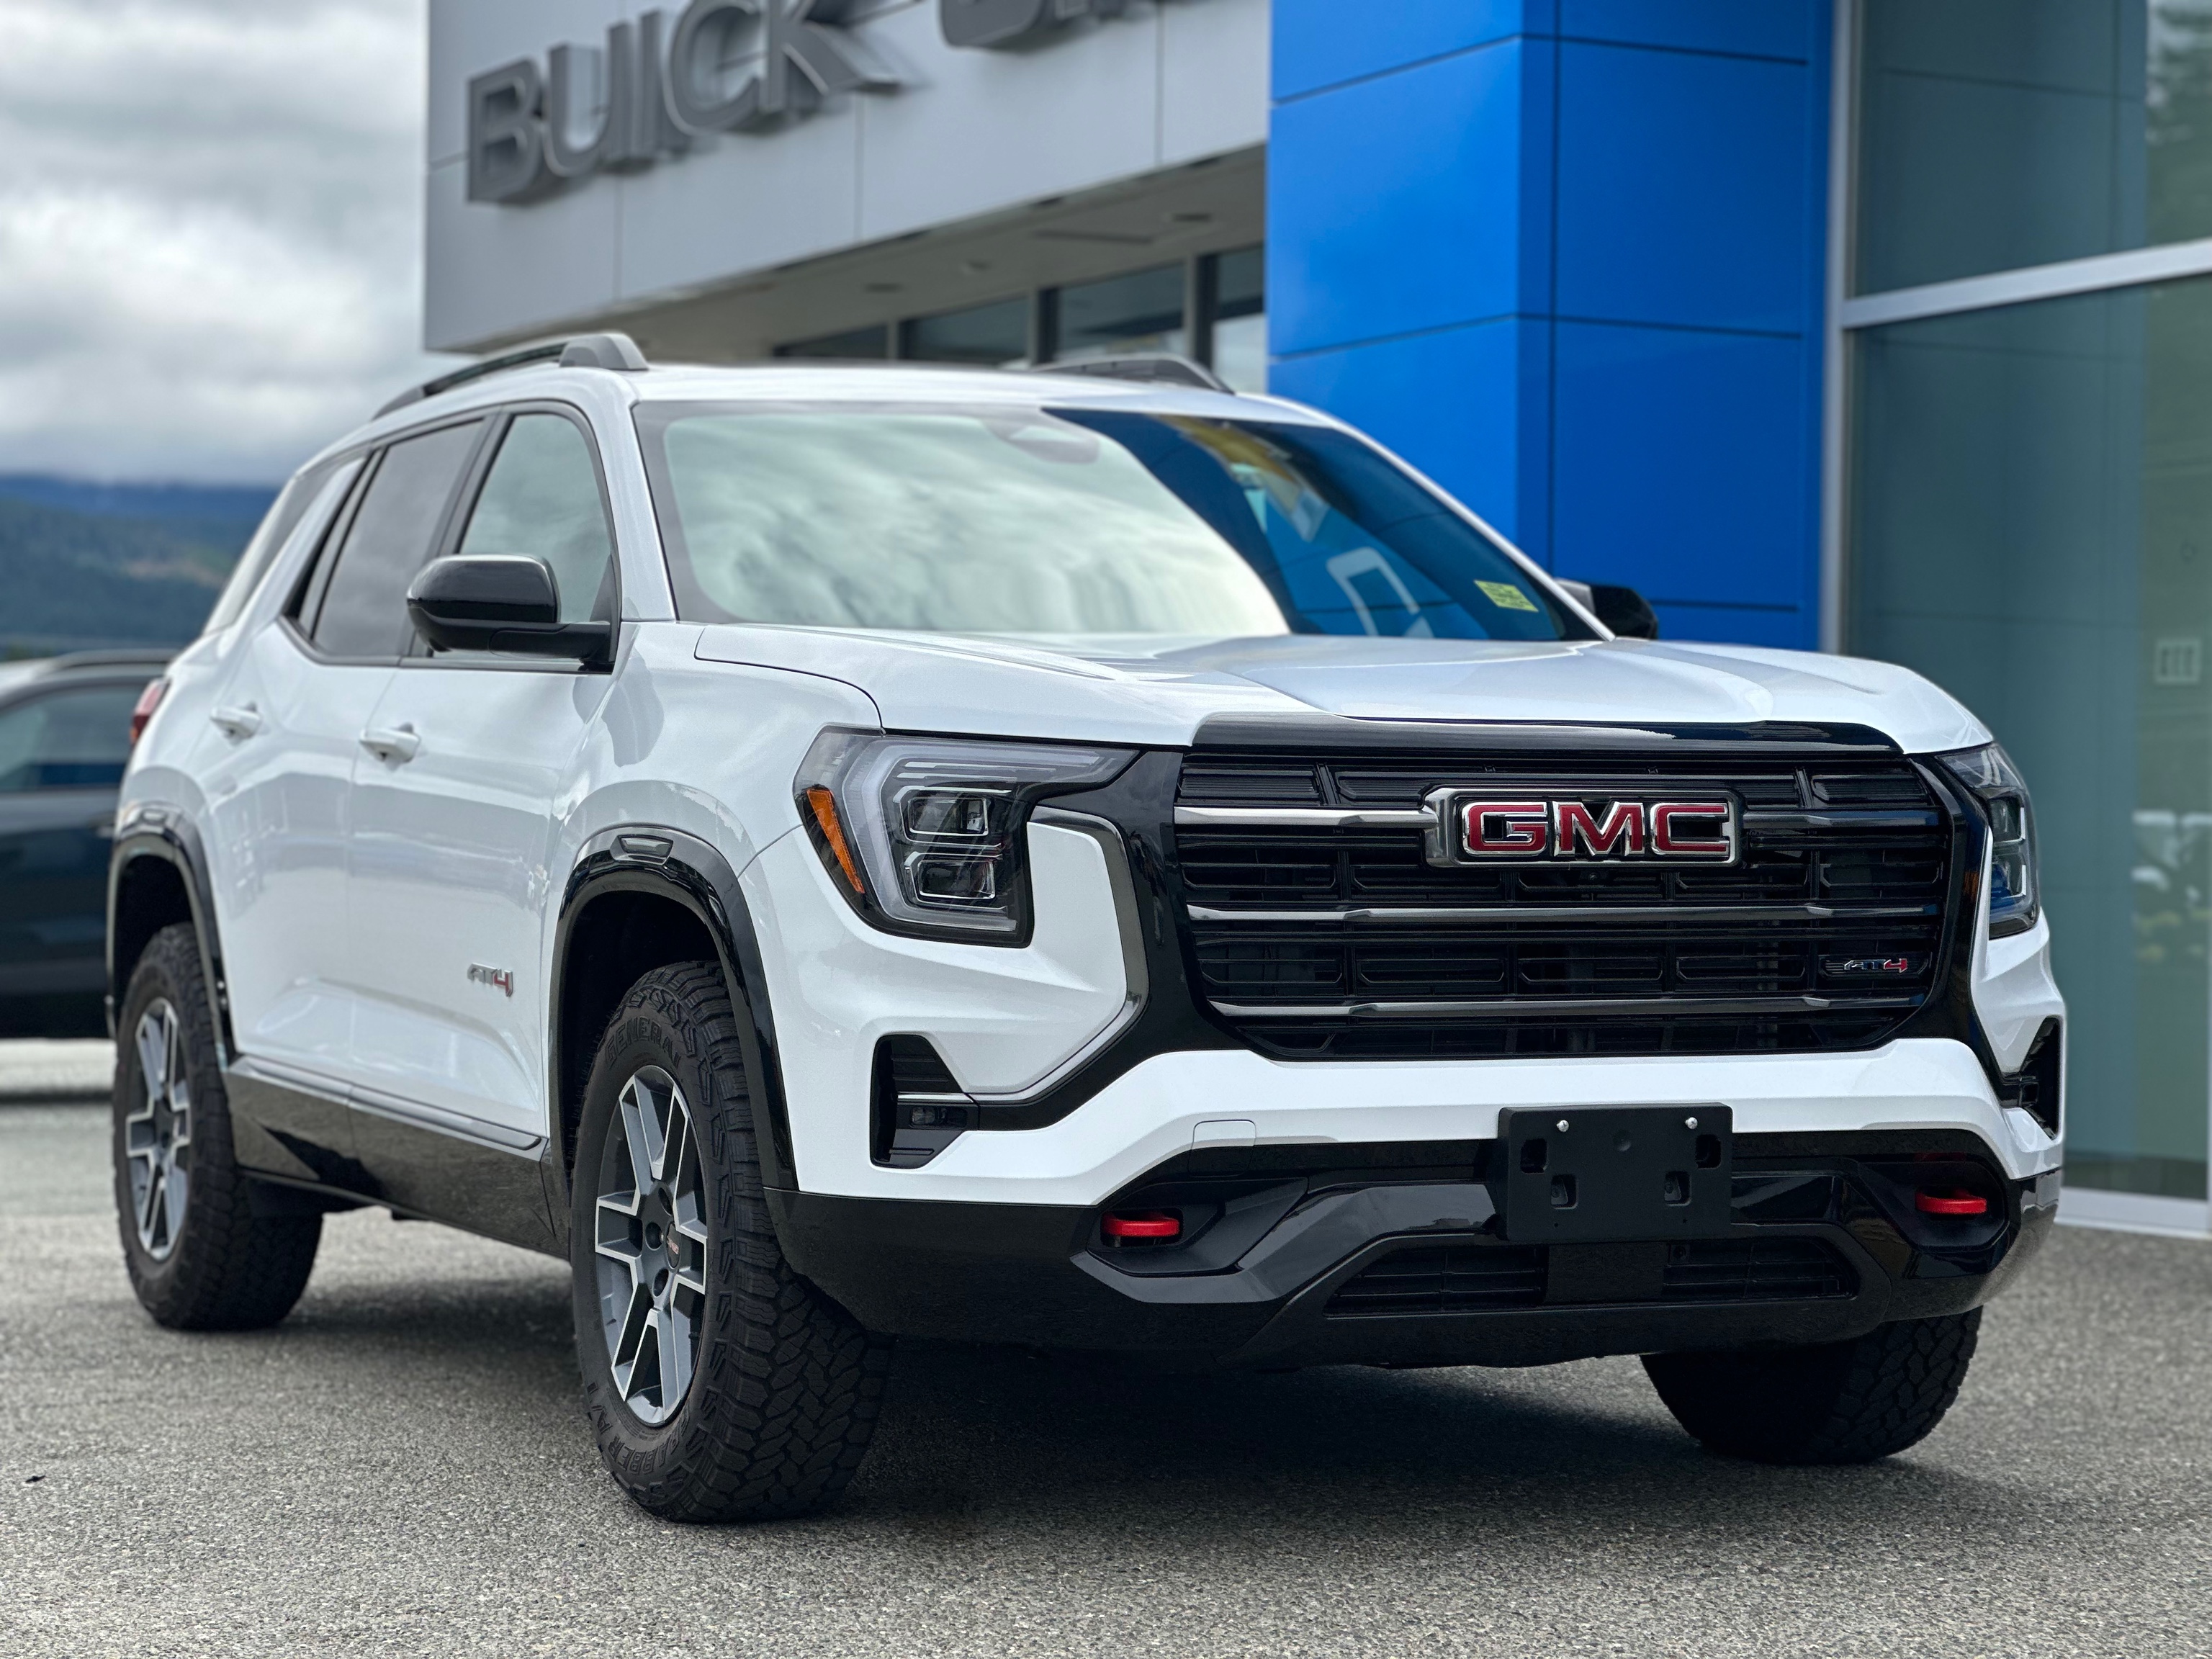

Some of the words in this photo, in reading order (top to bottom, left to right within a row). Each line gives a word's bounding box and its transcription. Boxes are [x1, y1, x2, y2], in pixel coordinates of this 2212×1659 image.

[467, 0, 882, 203] BUICK
[1462, 801, 1730, 857] GMC
[467, 963, 513, 997] AT4
[1844, 958, 1907, 974] AT4
